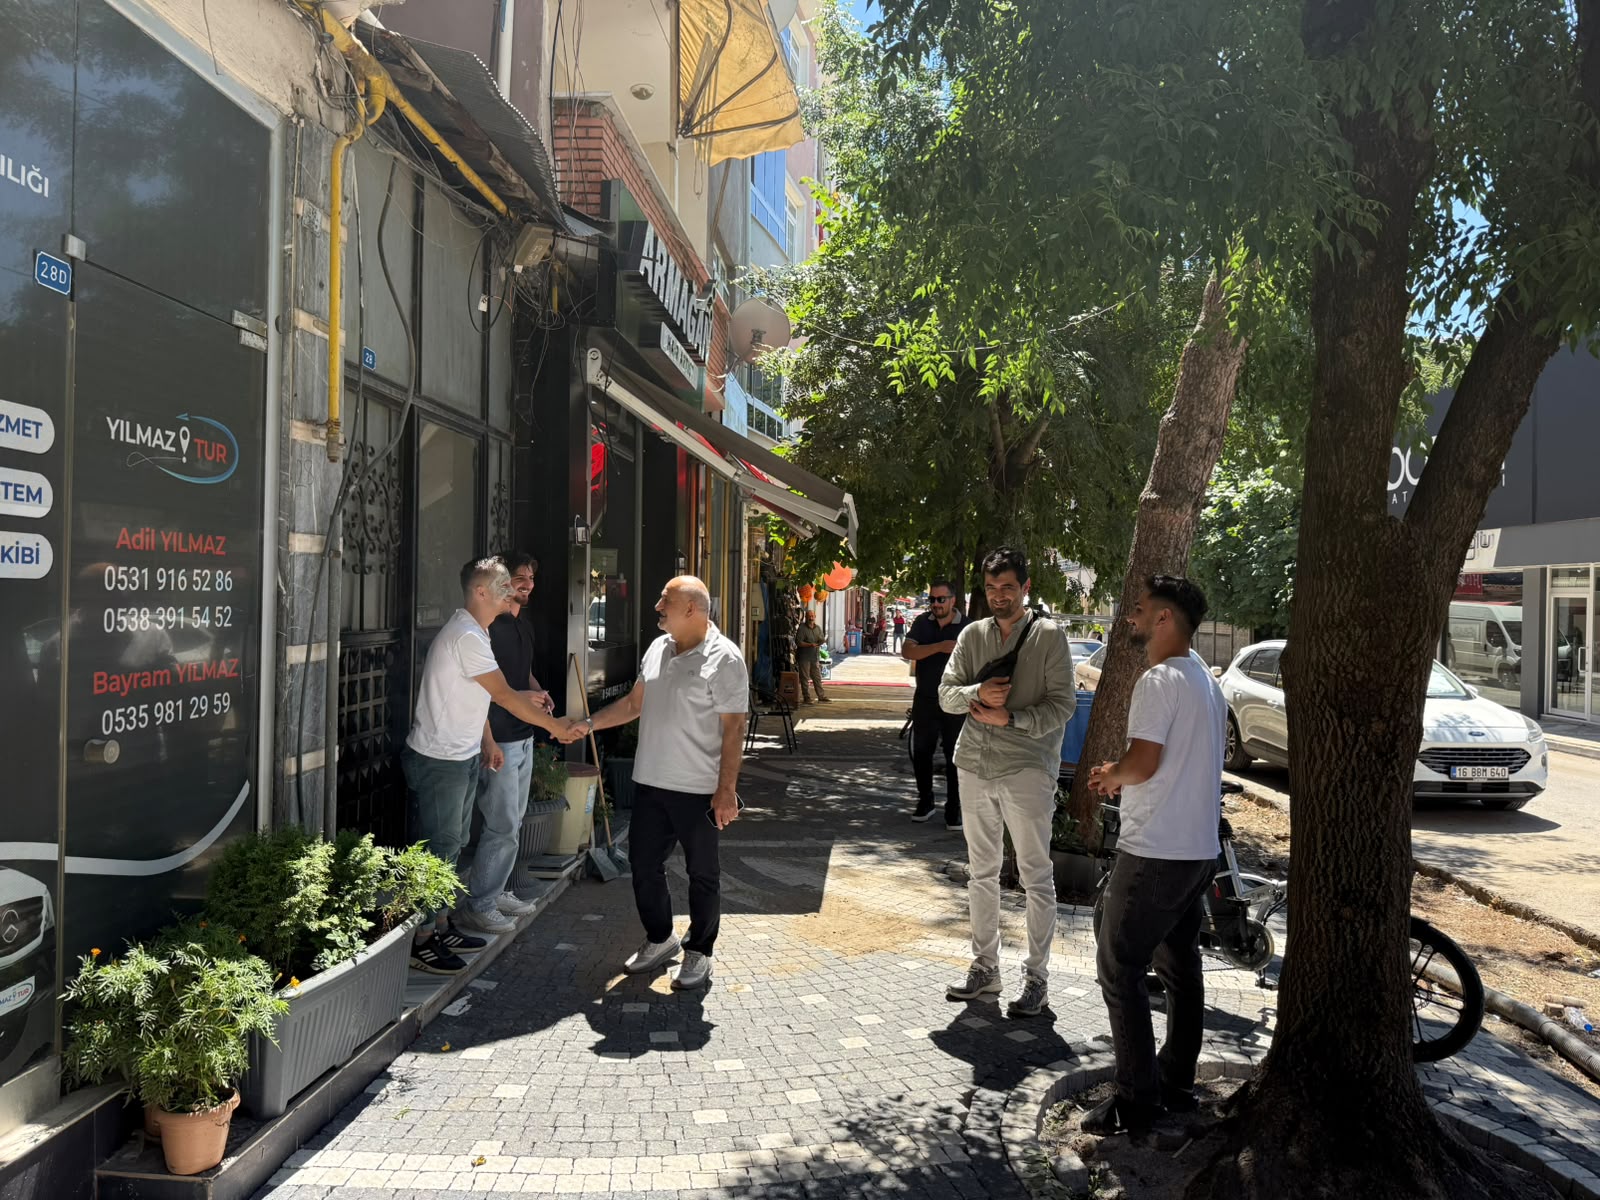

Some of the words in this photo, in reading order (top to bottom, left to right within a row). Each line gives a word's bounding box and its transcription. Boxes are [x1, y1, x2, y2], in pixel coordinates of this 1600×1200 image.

[40, 261, 67, 285] 28D
[106, 416, 176, 452] YILMAZ
[193, 438, 228, 464] TUR
[0, 541, 40, 565] KİBİ
[116, 528, 156, 551] Adil
[160, 531, 227, 556] YILMAZ
[104, 566, 149, 591] 0531
[156, 568, 187, 591] 916
[192, 569, 211, 591] 52
[215, 570, 233, 591] 86
[103, 608, 150, 633] 0538
[155, 607, 185, 630] 391
[192, 606, 210, 628] 54
[215, 606, 232, 627] 52
[93, 669, 171, 697] Bayram
[175, 658, 240, 684] YILMAZ
[102, 704, 149, 735] 0535
[154, 699, 183, 725] 981
[189, 695, 208, 719] 29
[213, 692, 231, 715] 59
[1457, 767, 1468, 777] 16
[1471, 767, 1488, 777] BBM
[1490, 767, 1506, 777] 640
